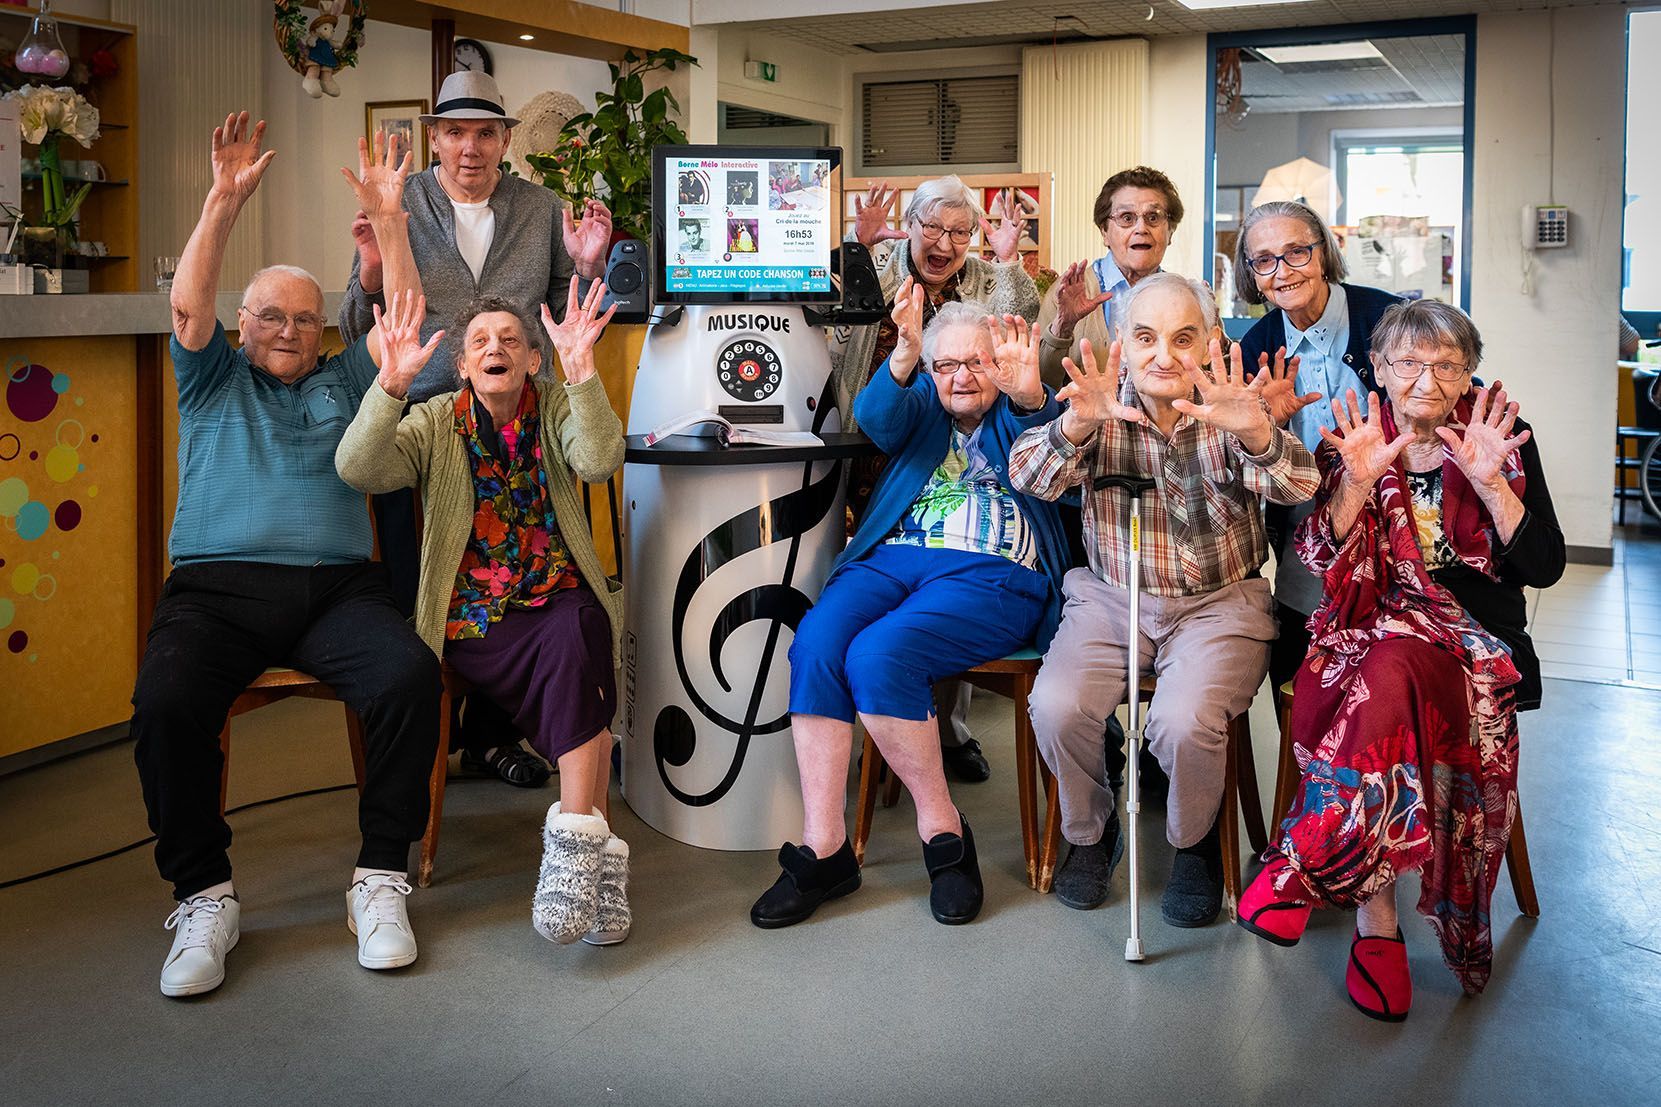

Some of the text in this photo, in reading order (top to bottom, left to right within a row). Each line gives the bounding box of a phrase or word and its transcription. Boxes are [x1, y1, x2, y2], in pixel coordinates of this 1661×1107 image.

[784, 230, 812, 238] 16h53
[697, 270, 722, 278] TAPEZ
[724, 270, 736, 278] UN
[738, 270, 761, 278] CODE
[763, 270, 804, 278] CHANSON
[708, 314, 790, 333] MUSIQUE
